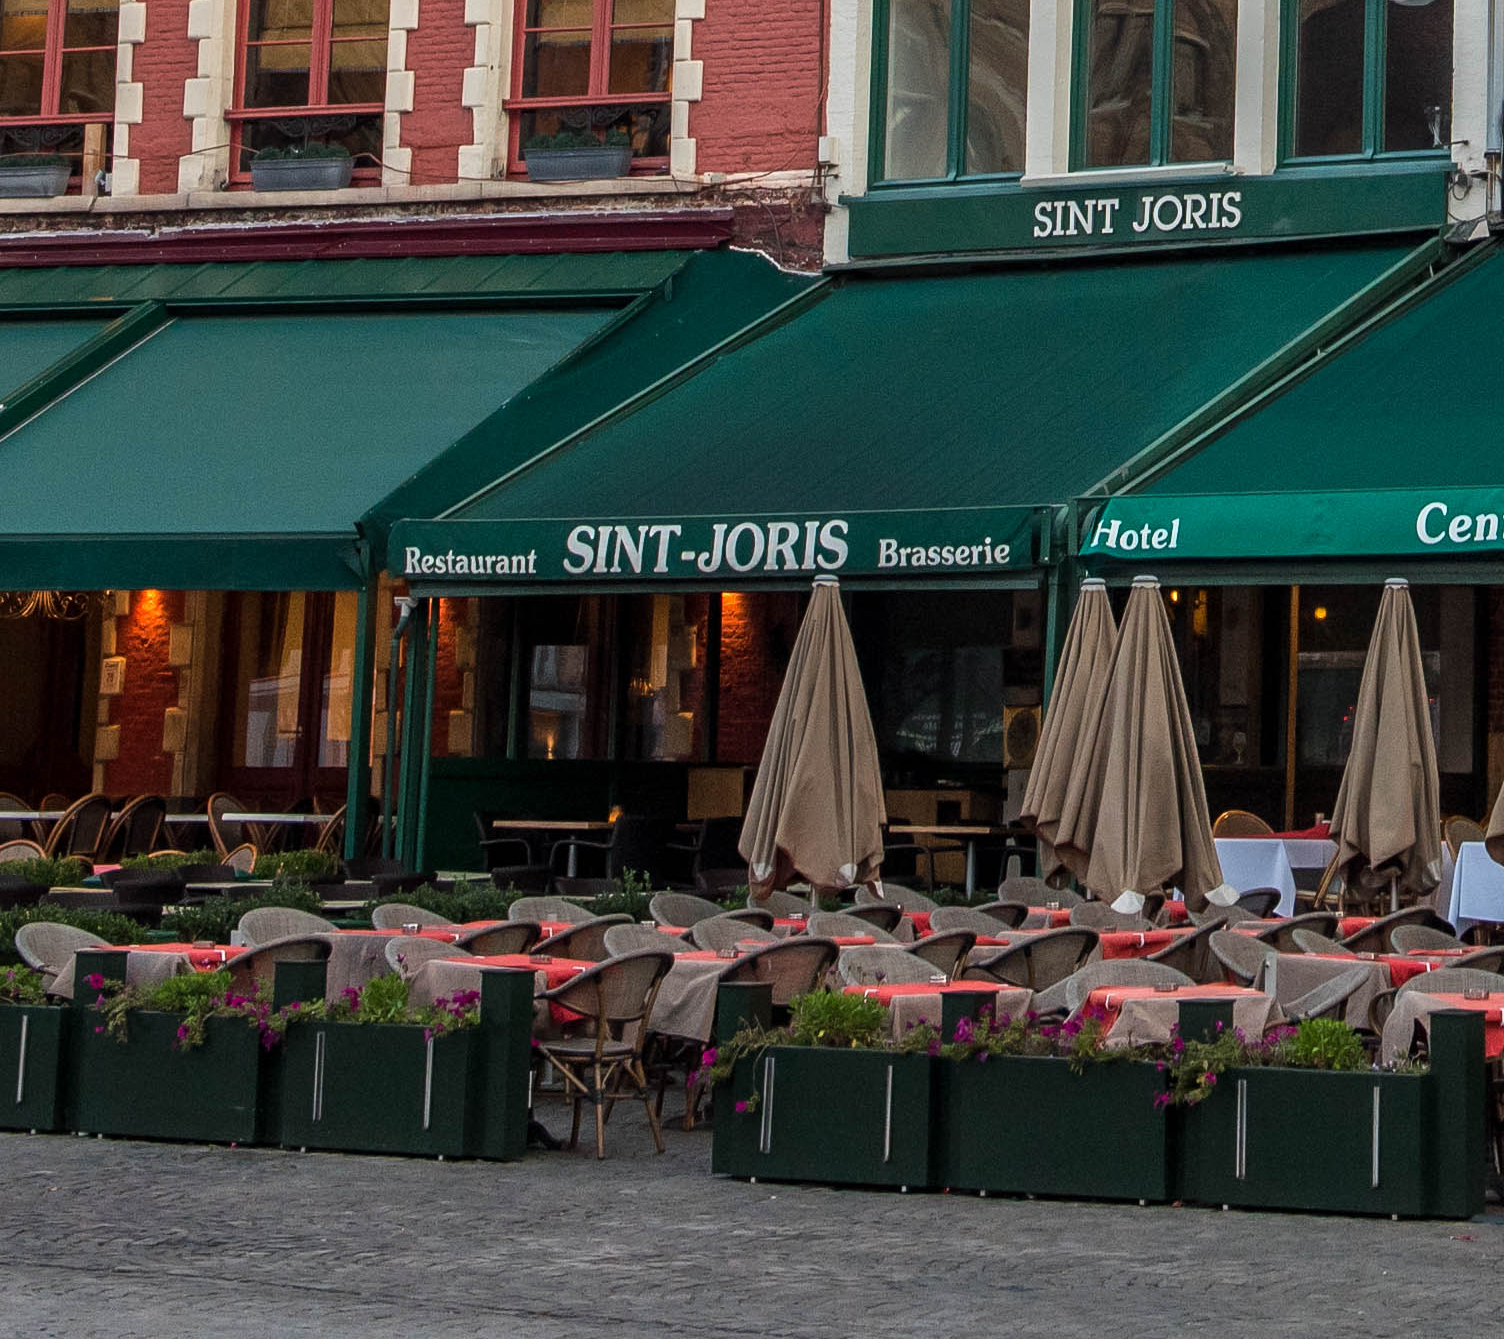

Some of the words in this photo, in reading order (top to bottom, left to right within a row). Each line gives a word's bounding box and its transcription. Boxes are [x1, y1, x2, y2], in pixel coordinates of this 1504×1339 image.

[1033, 198, 1120, 238] SINT
[1132, 191, 1242, 233] JORIS
[404, 546, 537, 575] Restaurant
[562, 519, 850, 577] SINT-JORIS
[877, 536, 1010, 568] Brasserie
[1090, 518, 1180, 551] Hotel
